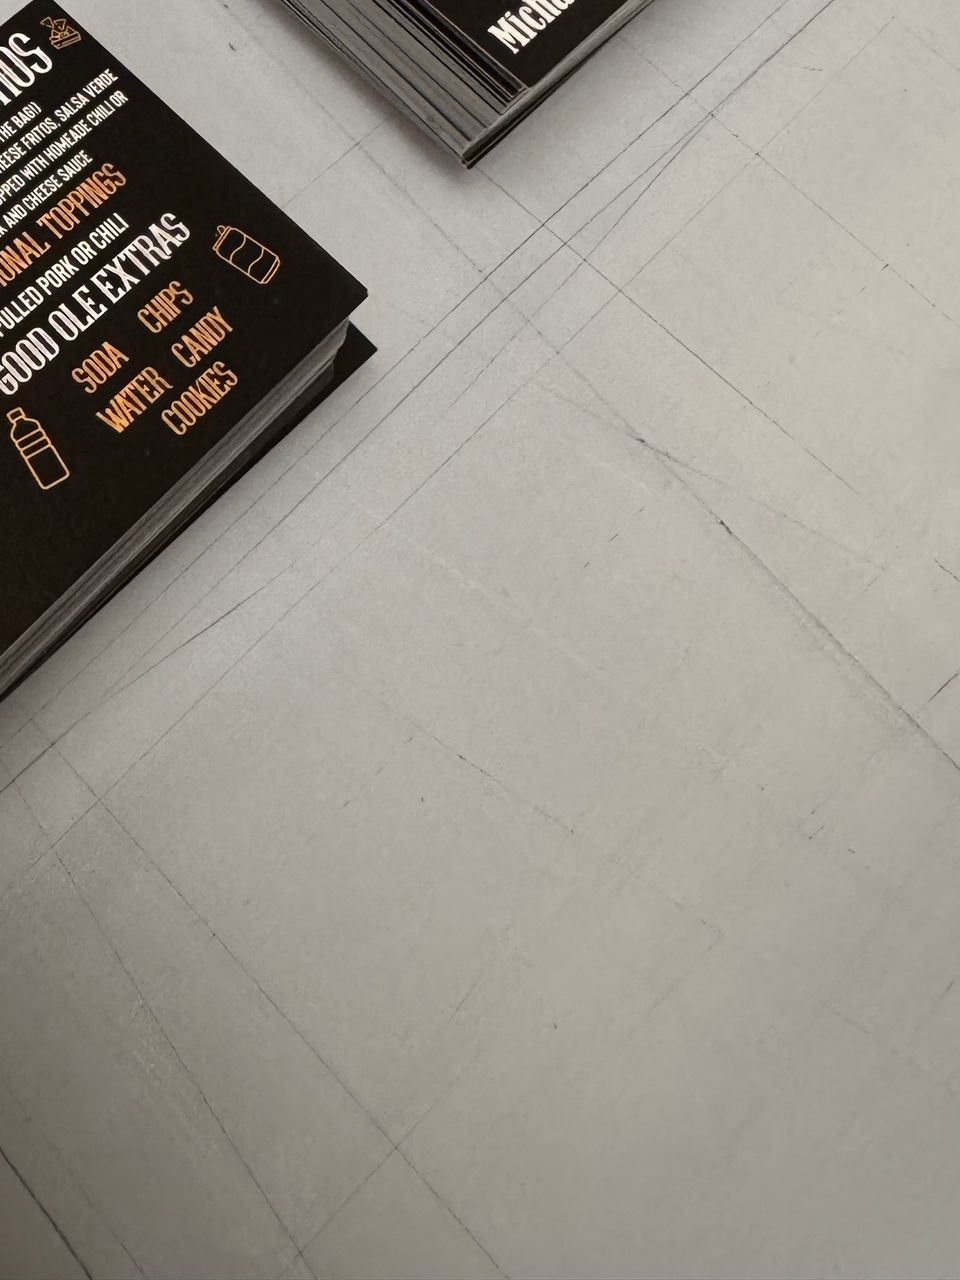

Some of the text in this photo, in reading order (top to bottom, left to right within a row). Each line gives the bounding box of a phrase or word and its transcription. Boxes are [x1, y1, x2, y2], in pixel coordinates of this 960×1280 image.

[19, 154, 50, 181] WITH
[42, 118, 93, 162] HOMEADE
[86, 100, 116, 127] CHILI
[109, 90, 129, 108] OR
[53, 92, 90, 122] SALSA
[82, 68, 119, 98] VERDE
[2, 203, 28, 229] AND
[21, 174, 64, 211] CHEESE
[56, 149, 94, 182] SAUCE
[35, 162, 127, 240] TOPPINGS
[35, 254, 80, 296] PORK
[70, 240, 98, 266] OR
[88, 212, 130, 250] CHILI
[48, 284, 109, 341] OLE
[89, 212, 191, 304] EXTRAS
[71, 280, 194, 394] SODA CHIPS
[95, 305, 233, 434] WATER CANDY
[161, 361, 238, 435] COOKIES
